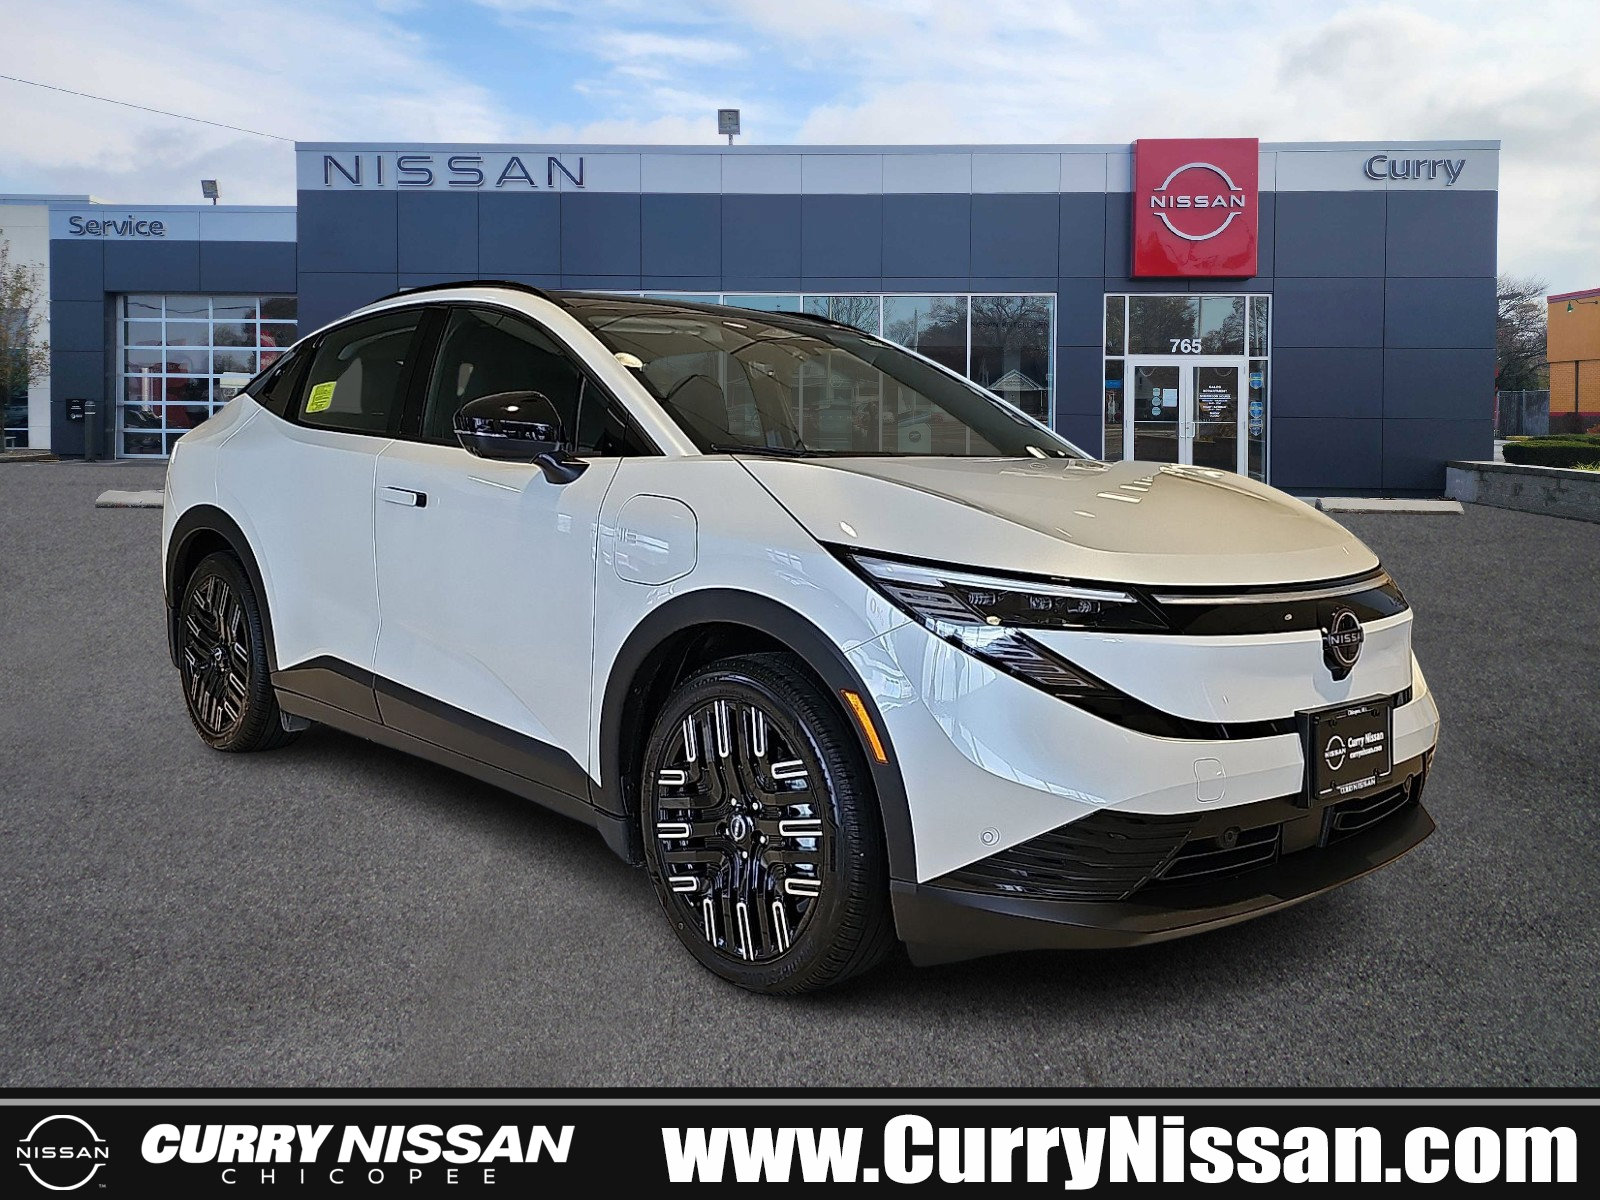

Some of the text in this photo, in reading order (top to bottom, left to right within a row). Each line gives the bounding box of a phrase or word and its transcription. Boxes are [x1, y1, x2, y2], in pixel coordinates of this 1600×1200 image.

[323, 154, 585, 188] NISSAN
[1364, 154, 1467, 187] Curry
[1150, 194, 1246, 208] NISSAN
[68, 214, 165, 236] Service
[1169, 338, 1202, 354] 765
[1347, 731, 1384, 748] Curry Nissan
[1324, 748, 1346, 759] NISSAN
